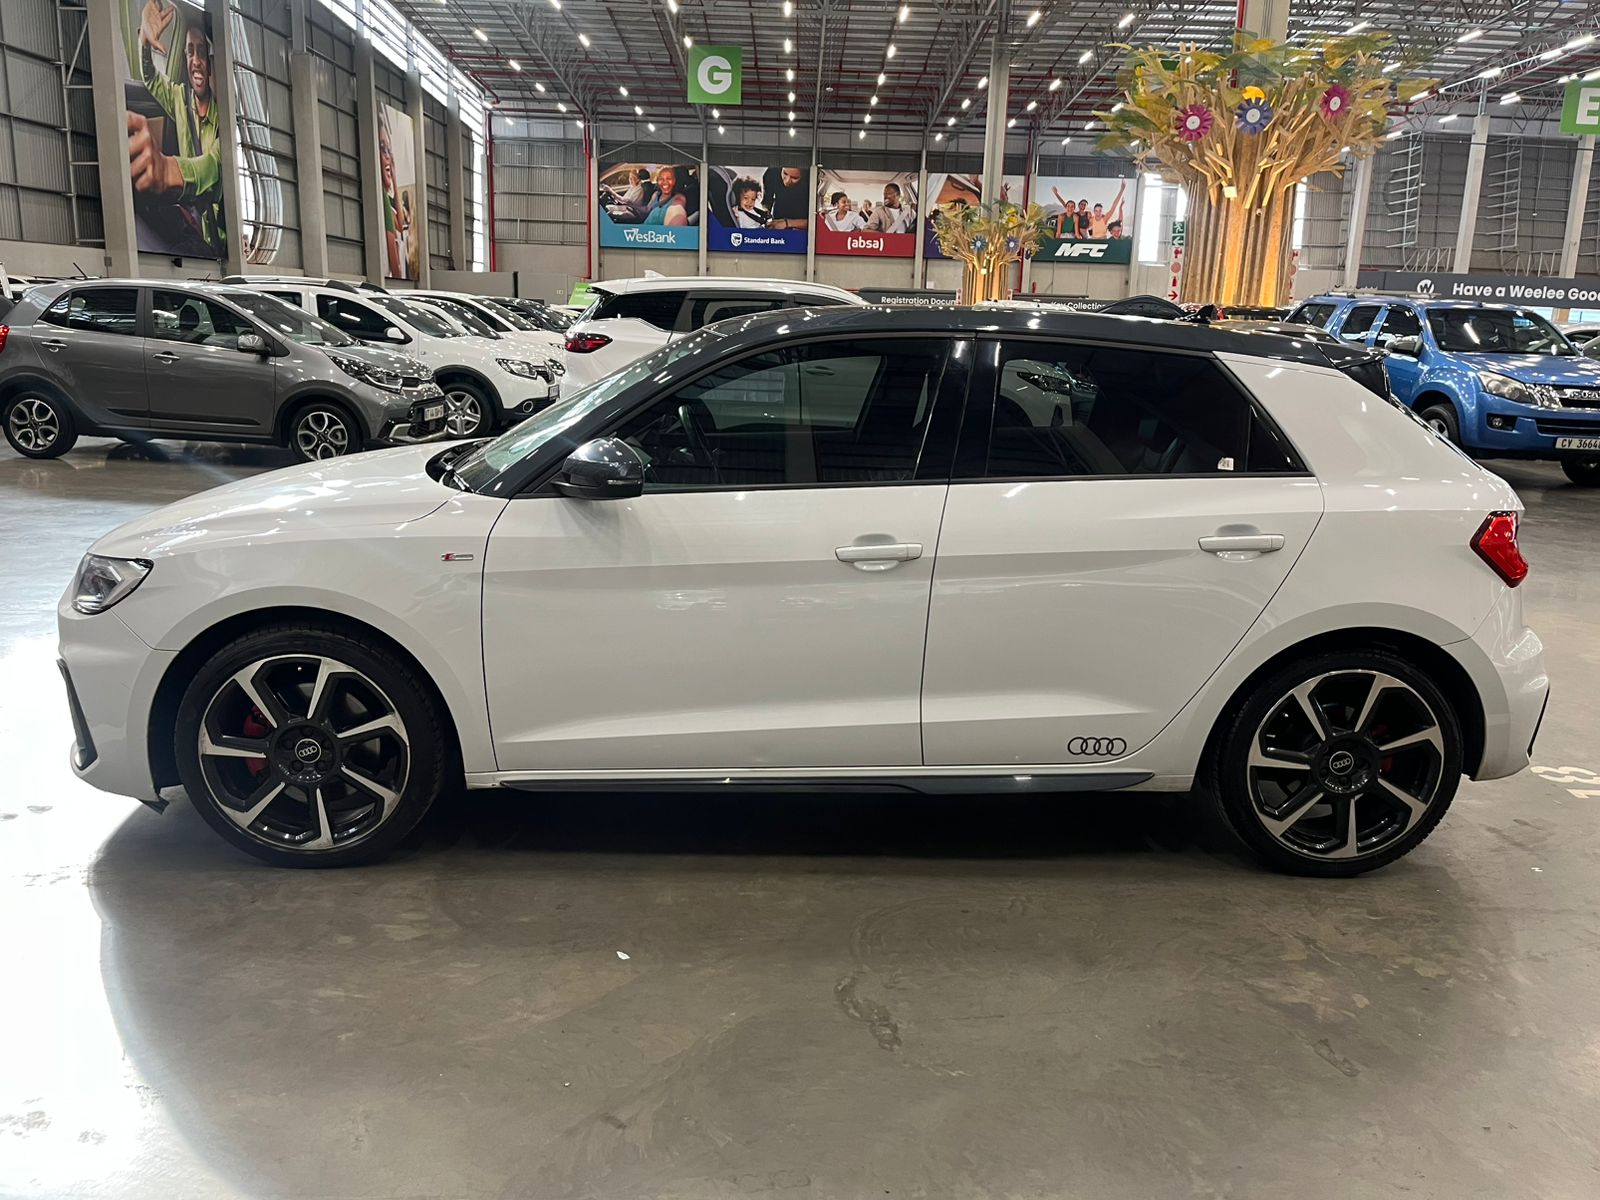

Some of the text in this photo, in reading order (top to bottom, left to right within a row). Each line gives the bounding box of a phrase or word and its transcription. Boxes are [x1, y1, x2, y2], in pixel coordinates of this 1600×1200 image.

[697, 55, 732, 95] G
[1576, 87, 1600, 125] E
[623, 228, 676, 244] WesBank
[770, 237, 786, 245] Bank
[847, 236, 884, 251] (absa)
[1054, 243, 1109, 258] MFC
[1452, 282, 1600, 302] Have a Weelee Goo
[881, 296, 929, 305] Registration
[1067, 301, 1106, 310] Collectio
